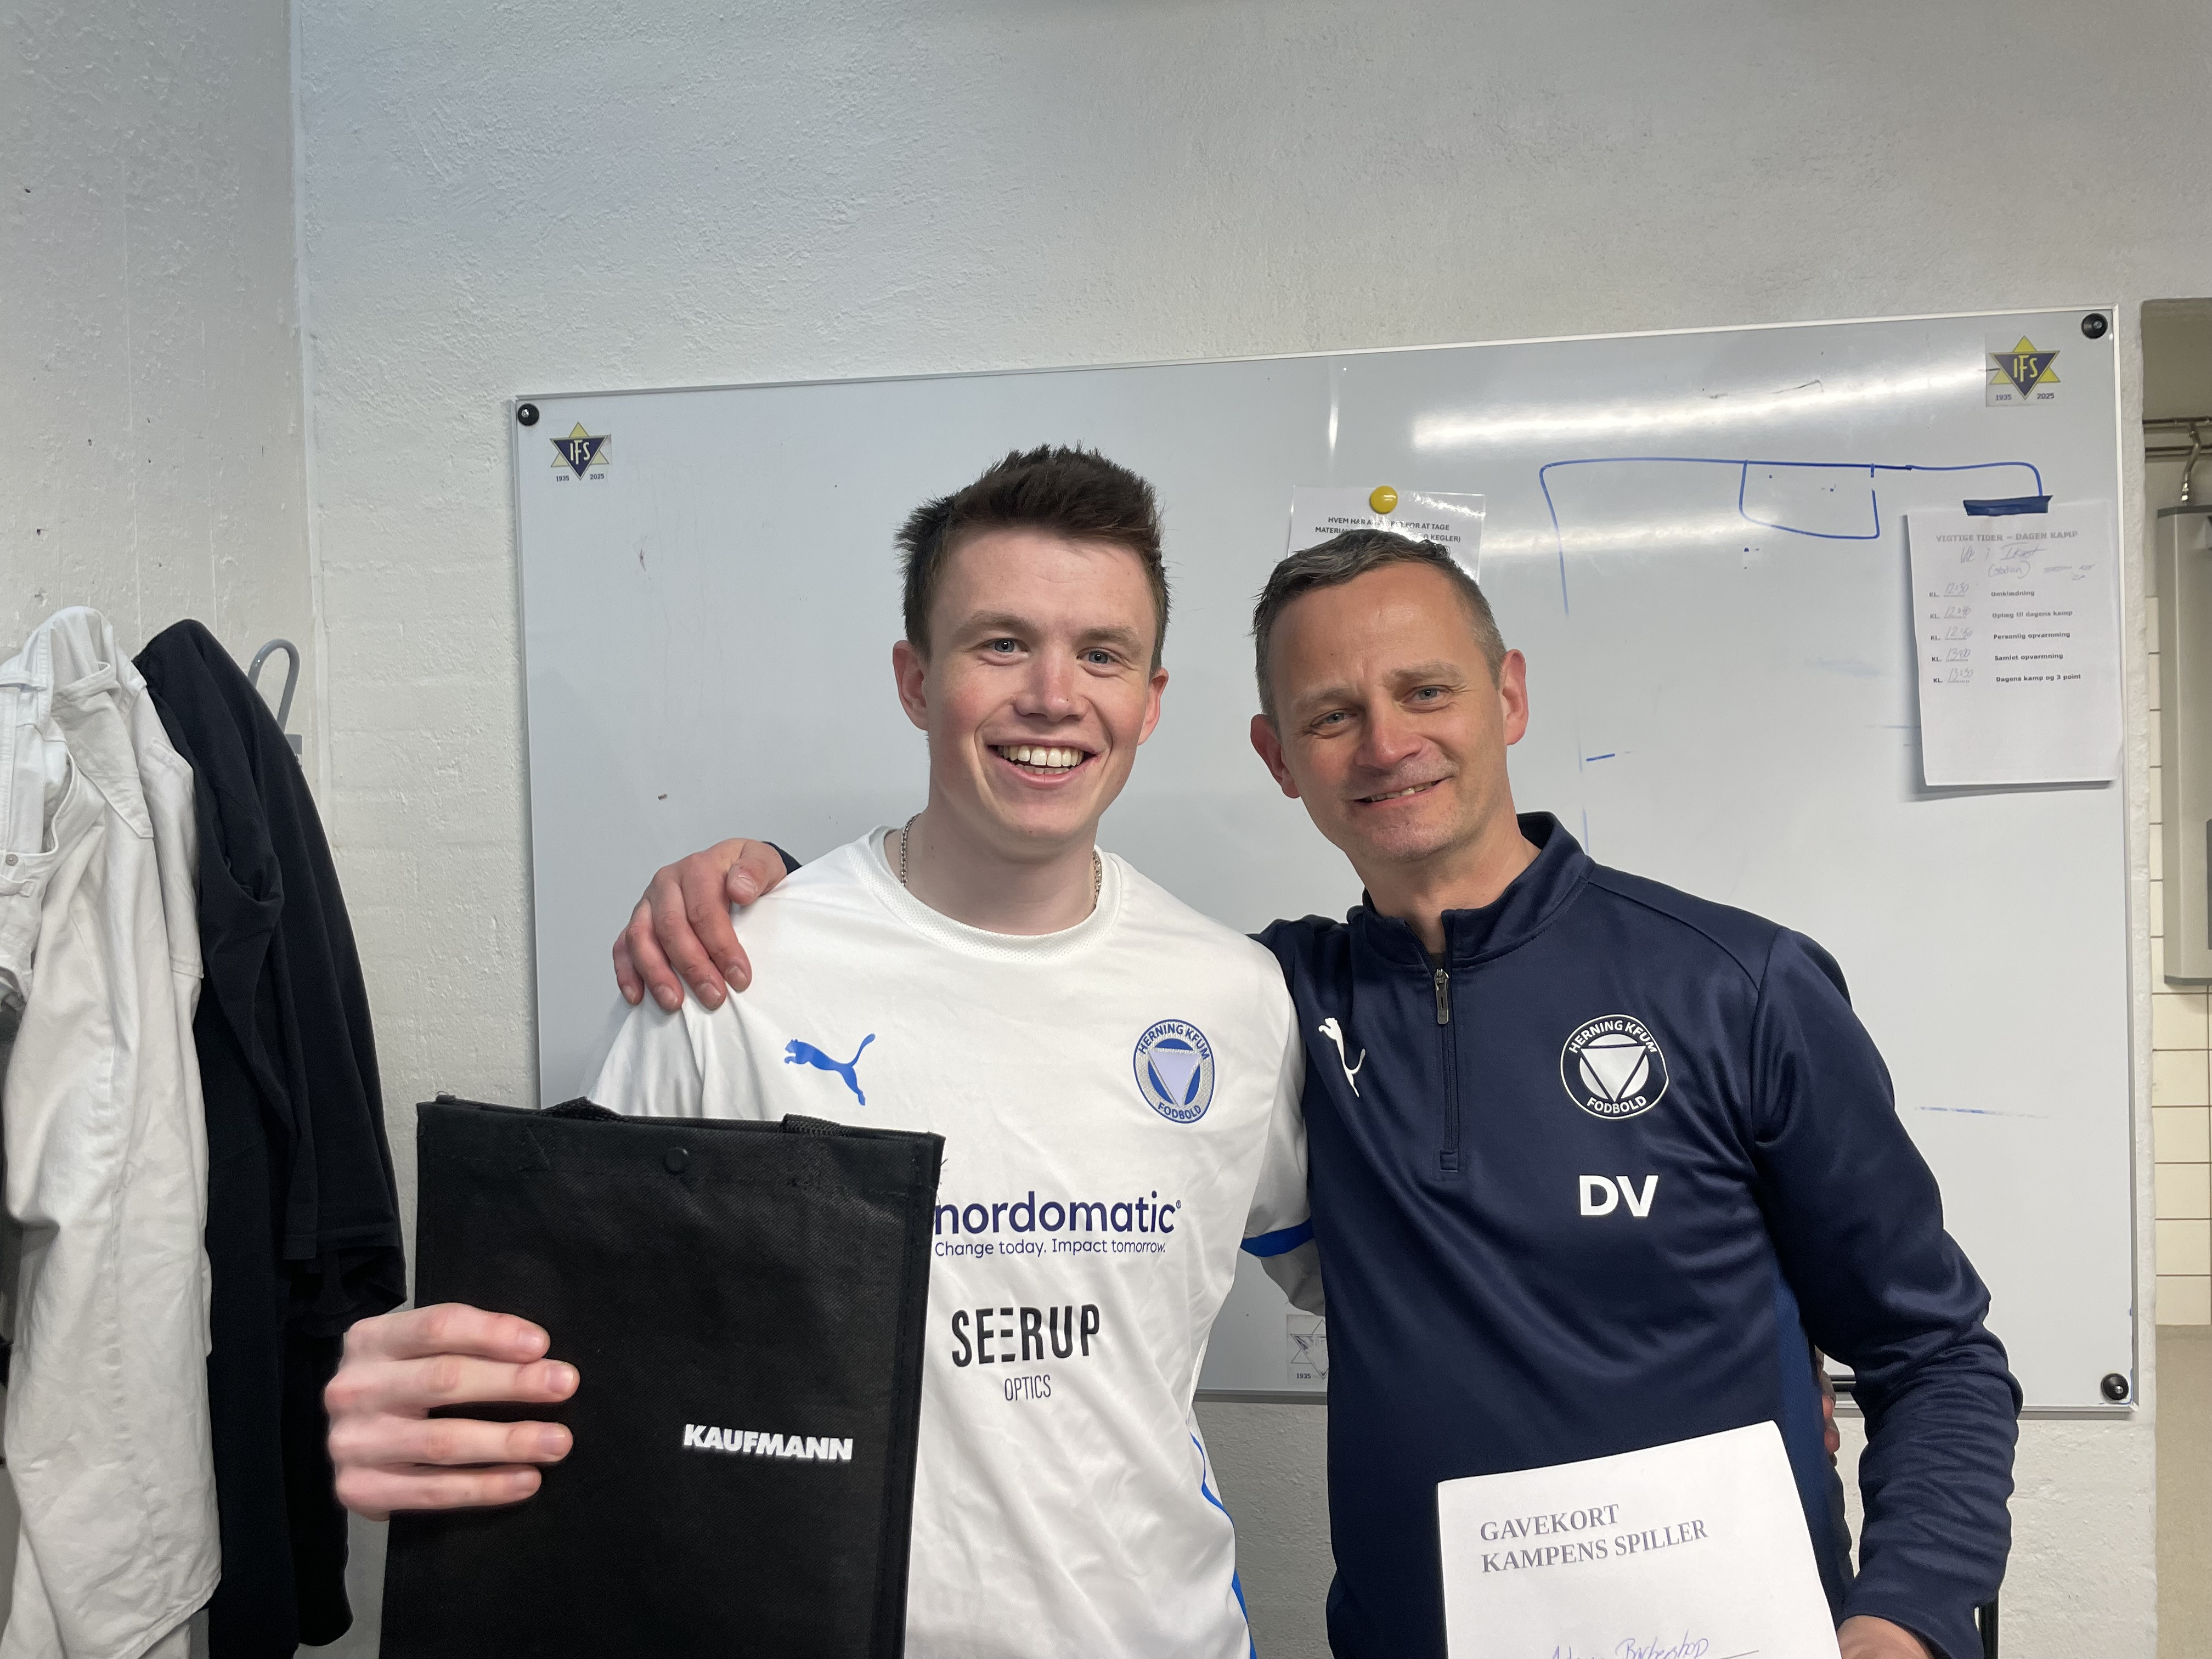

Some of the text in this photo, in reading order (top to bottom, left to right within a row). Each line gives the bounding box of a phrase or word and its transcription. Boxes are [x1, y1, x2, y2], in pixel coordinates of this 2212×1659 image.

[2013, 354, 2038, 382] IFS
[570, 439, 590, 465] IFS
[1431, 534, 1461, 543] KEGLER)
[2015, 532, 2047, 540] DAGEN
[2050, 531, 2078, 539] KAMP
[1138, 1023, 1210, 1060] HERNING KFUM
[1568, 1020, 1657, 1053] HERNING KFUM
[1158, 1102, 1201, 1119] FODBOLD
[1587, 1096, 1646, 1114] FODBOLD
[1579, 1175, 1658, 1217] DV
[935, 1238, 1166, 1258] Change today. Impact tomorrow.
[951, 1304, 1100, 1367] SEERUP
[1005, 1374, 1051, 1401] OPTICS
[684, 1423, 853, 1460] KAUFMANN
[1480, 1503, 1620, 1542] GAVEKORT
[1481, 1519, 1708, 1573] KAMPENS SPILLER
